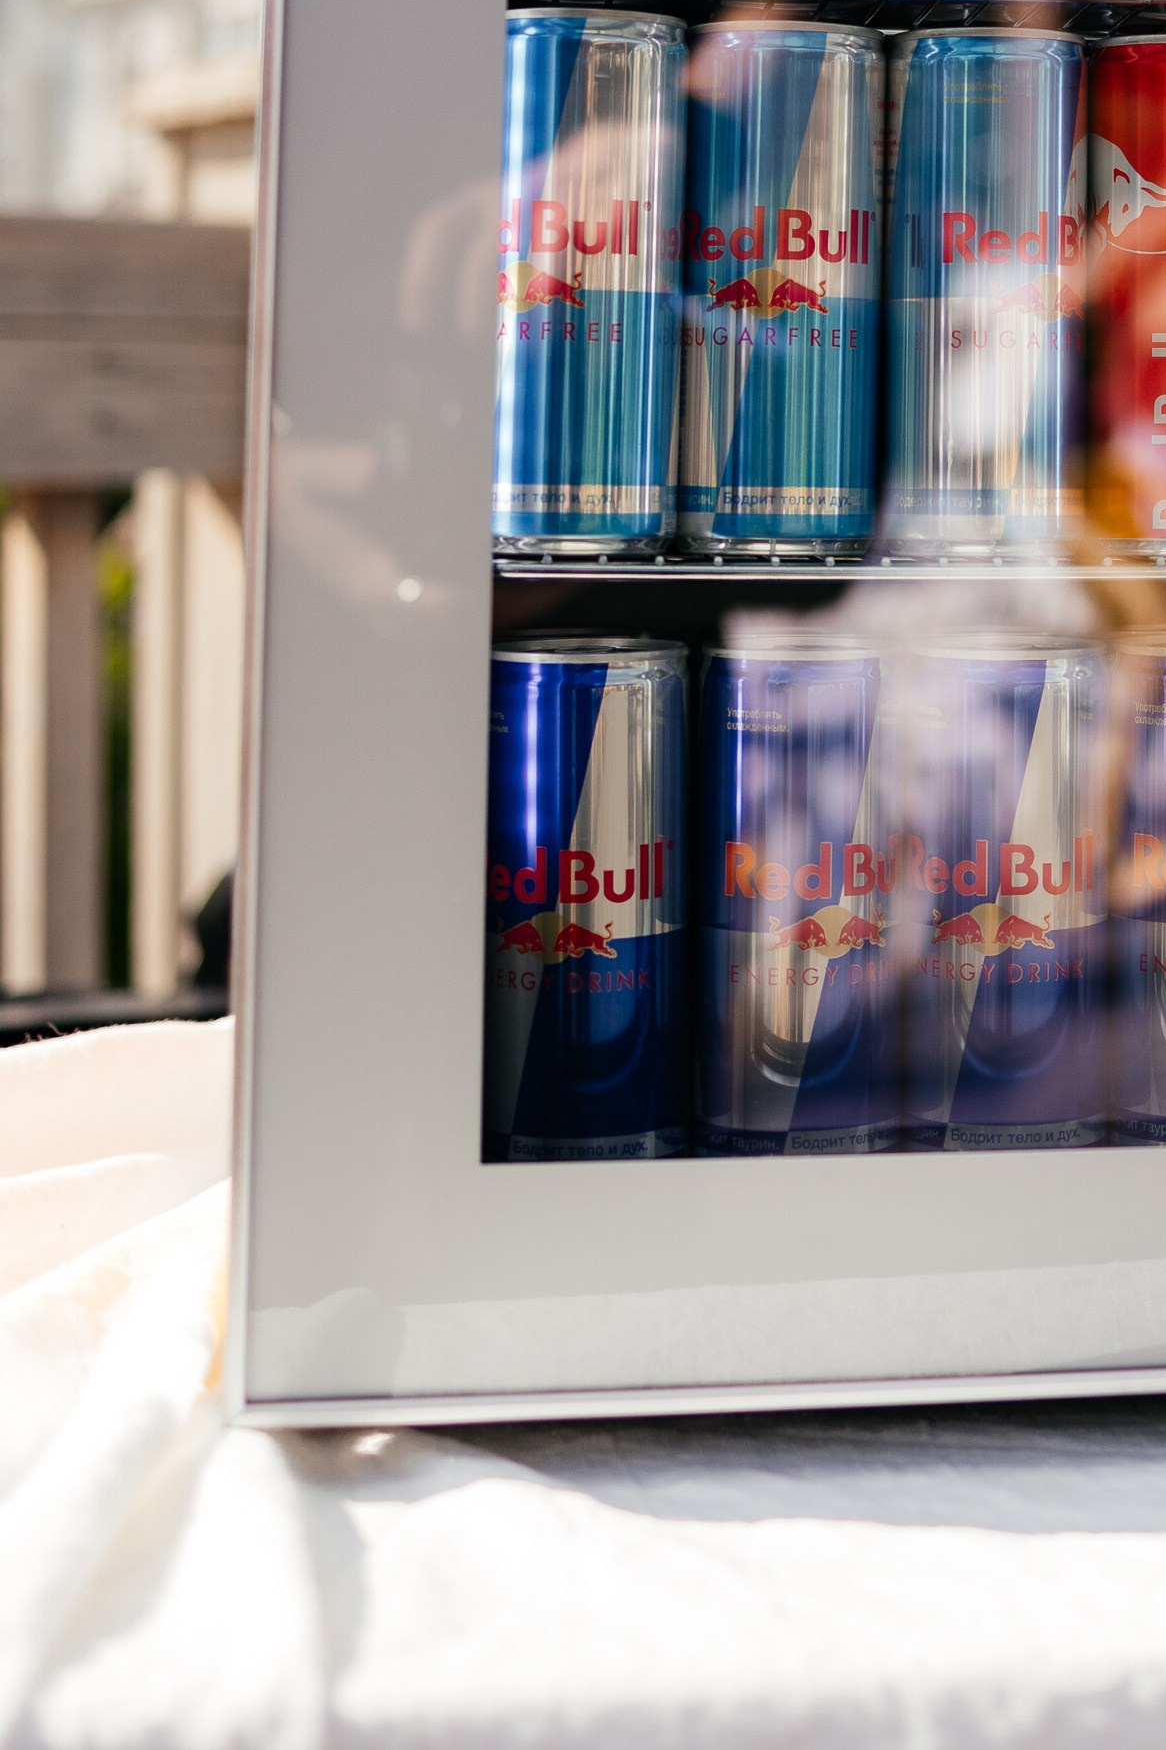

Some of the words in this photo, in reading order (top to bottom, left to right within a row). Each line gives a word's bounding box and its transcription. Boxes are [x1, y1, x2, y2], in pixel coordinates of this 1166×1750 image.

[531, 199, 639, 256] Bull
[776, 208, 869, 265] Bull
[943, 211, 1049, 265] Red
[497, 321, 623, 343] ARFREE
[723, 492, 775, 507] Бодрит
[779, 494, 814, 506] тело
[727, 706, 782, 721] Употреблять
[726, 720, 789, 733] охлажденным.
[490, 847, 547, 905] ed
[560, 842, 663, 904] Bull
[725, 841, 833, 901] Red
[1000, 836, 1093, 897] Bull
[568, 969, 651, 993] DRINK
[730, 963, 839, 987] ENERGY
[918, 958, 996, 984] NERGY
[1007, 958, 1084, 984] DRINK
[732, 1134, 780, 1151] таурин.
[791, 1135, 844, 1151] Бодрит
[951, 1128, 1002, 1146] Бодрит
[1007, 1131, 1041, 1144] тело
[1046, 1131, 1054, 1142] и
[568, 1142, 603, 1157] тело
